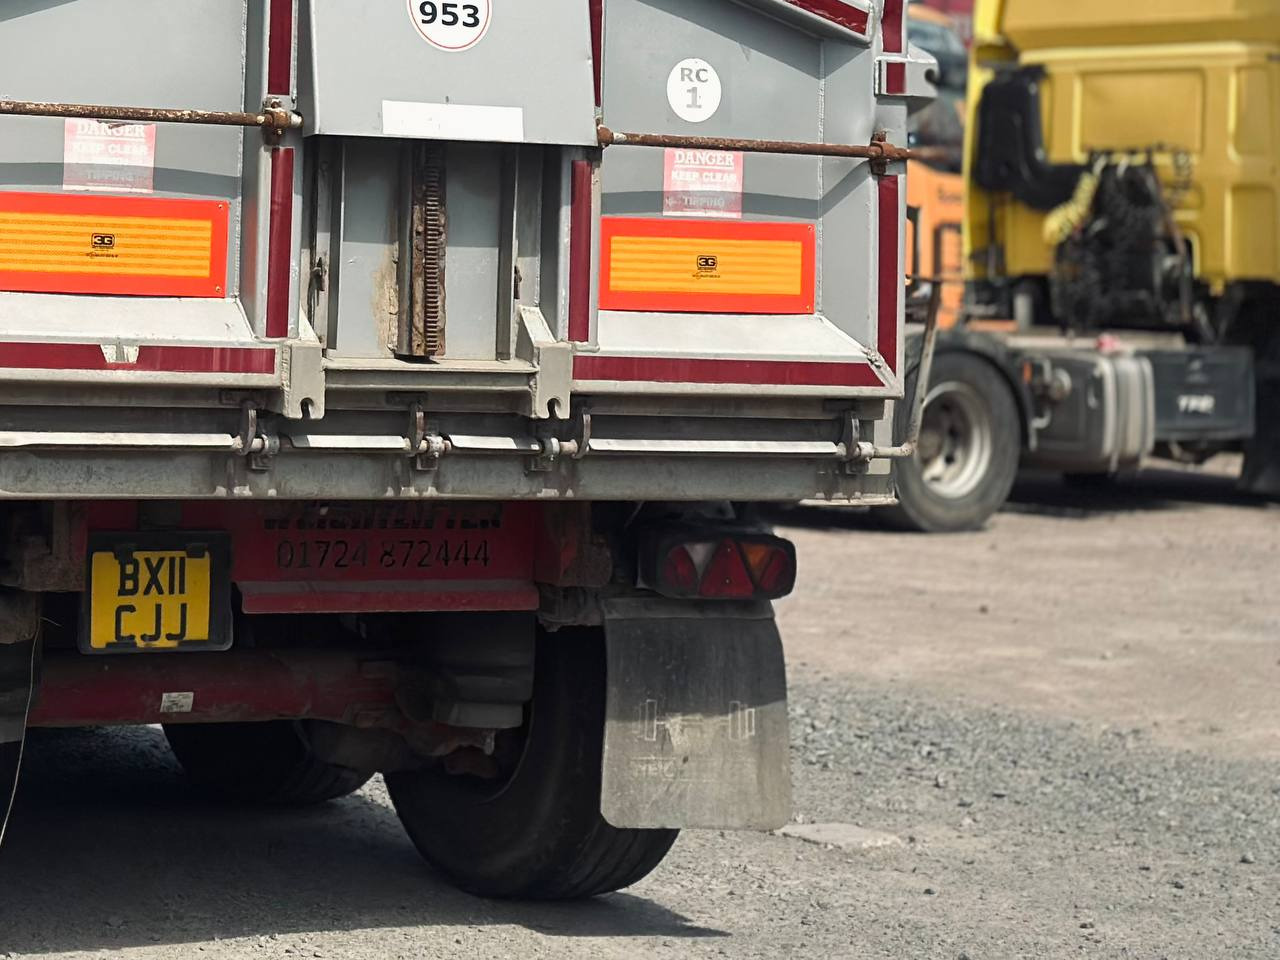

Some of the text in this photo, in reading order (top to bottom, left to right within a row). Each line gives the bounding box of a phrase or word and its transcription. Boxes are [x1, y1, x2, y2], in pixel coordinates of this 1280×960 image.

[419, 0, 480, 28] 953
[680, 67, 709, 83] RC
[686, 86, 702, 109] 1
[76, 122, 145, 138] DANGER
[674, 150, 734, 167] DANGER
[276, 540, 490, 568] 01724 872444
[117, 555, 187, 597] BX11
[115, 602, 188, 642] CJJ
